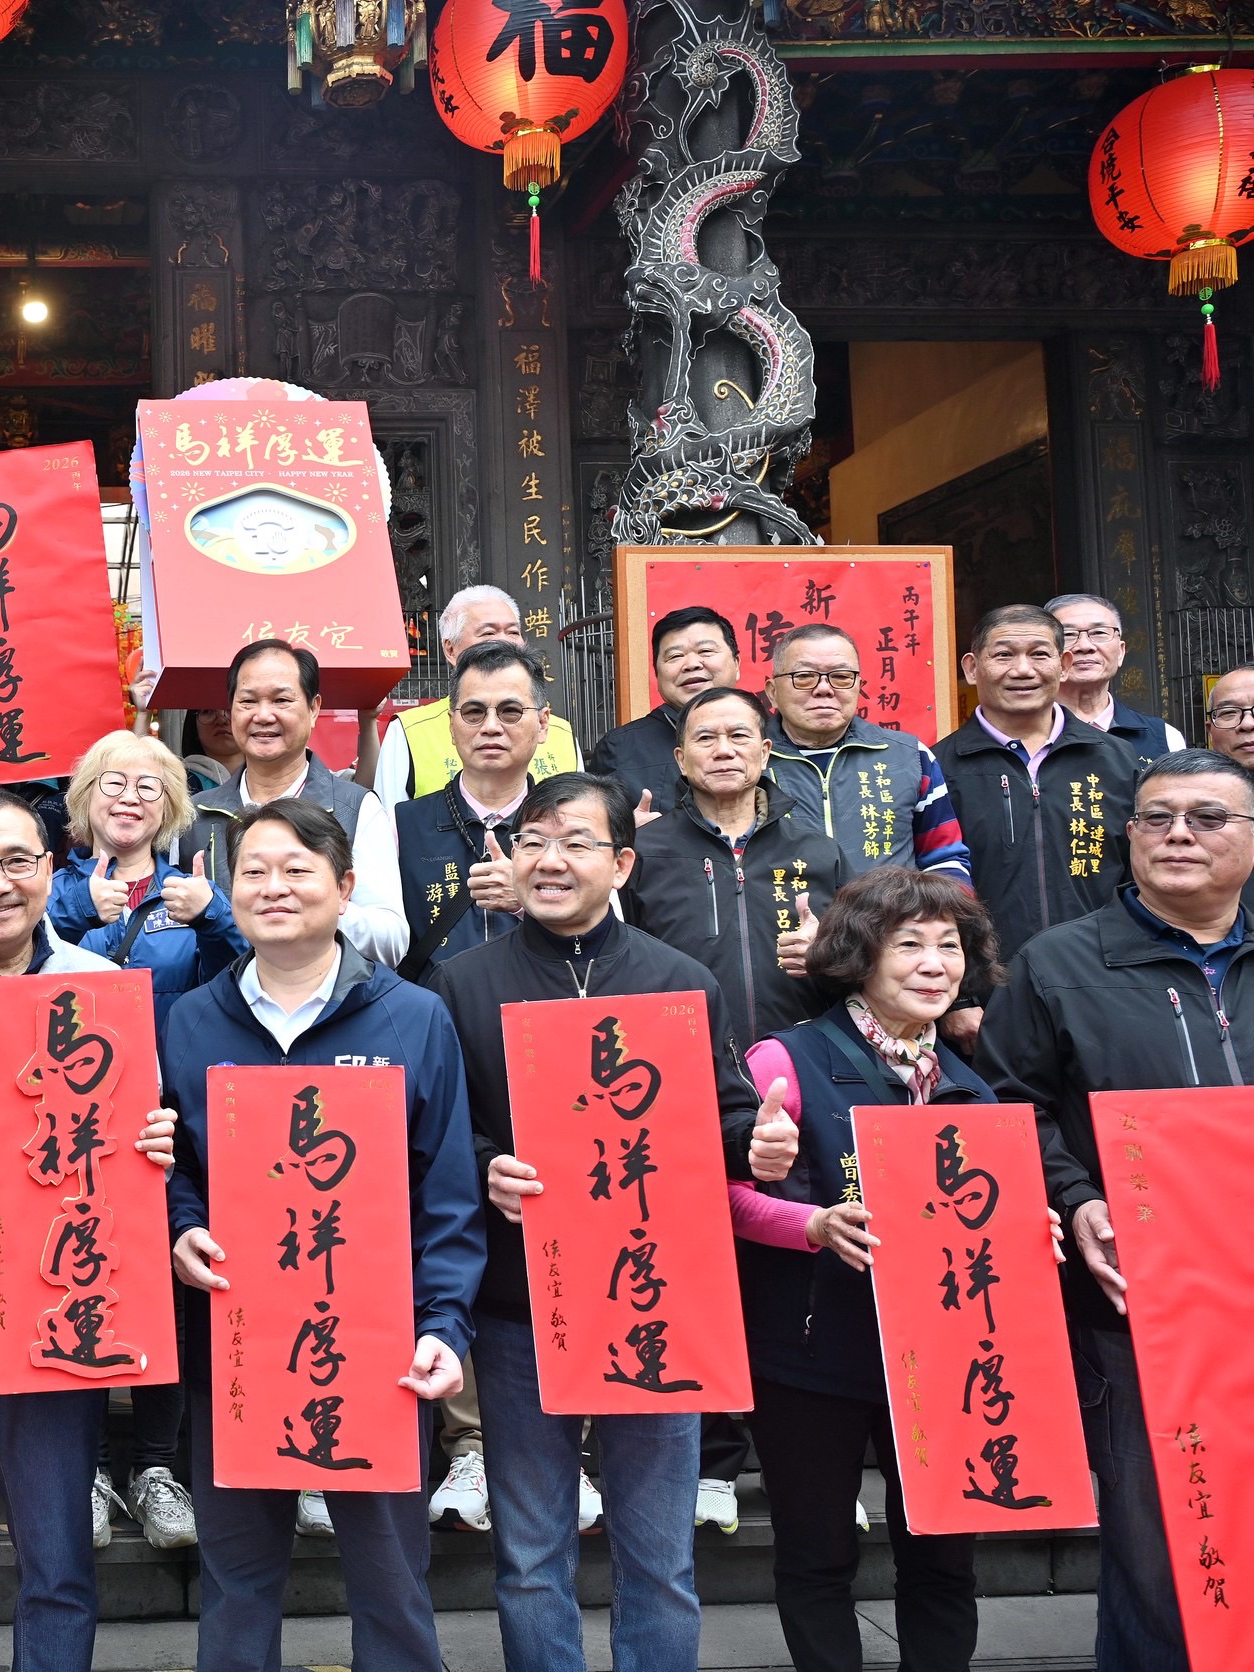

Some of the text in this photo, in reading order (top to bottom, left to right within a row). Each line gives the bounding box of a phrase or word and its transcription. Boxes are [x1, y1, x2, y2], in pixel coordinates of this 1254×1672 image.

[486, 0, 614, 84] 福
[43, 456, 80, 472] 2026
[168, 421, 365, 470] 馬祥厚運
[245, 470, 265, 478] CITY
[513, 344, 555, 683] 福澤被生民作蜡
[800, 579, 837, 621] 新
[903, 586, 920, 656] 丙午年
[857, 771, 875, 799] 里長
[873, 762, 894, 803] 中和區
[1086, 773, 1104, 819] 中和區
[882, 808, 896, 856] 安平里
[1069, 782, 1090, 878] 里長 林仁凱
[1088, 825, 1105, 873] 連城里
[444, 863, 460, 899] 監事
[773, 869, 789, 902] 里長
[660, 1004, 696, 1017] 2026
[27, 990, 136, 1366] 馬祥厚運
[571, 1015, 703, 1393] 馬祥厚運
[267, 1084, 373, 1470] 馬祥厚運
[920, 1123, 1053, 1510] 馬祥厚運
[1197, 1535, 1230, 1610] 敬賀
